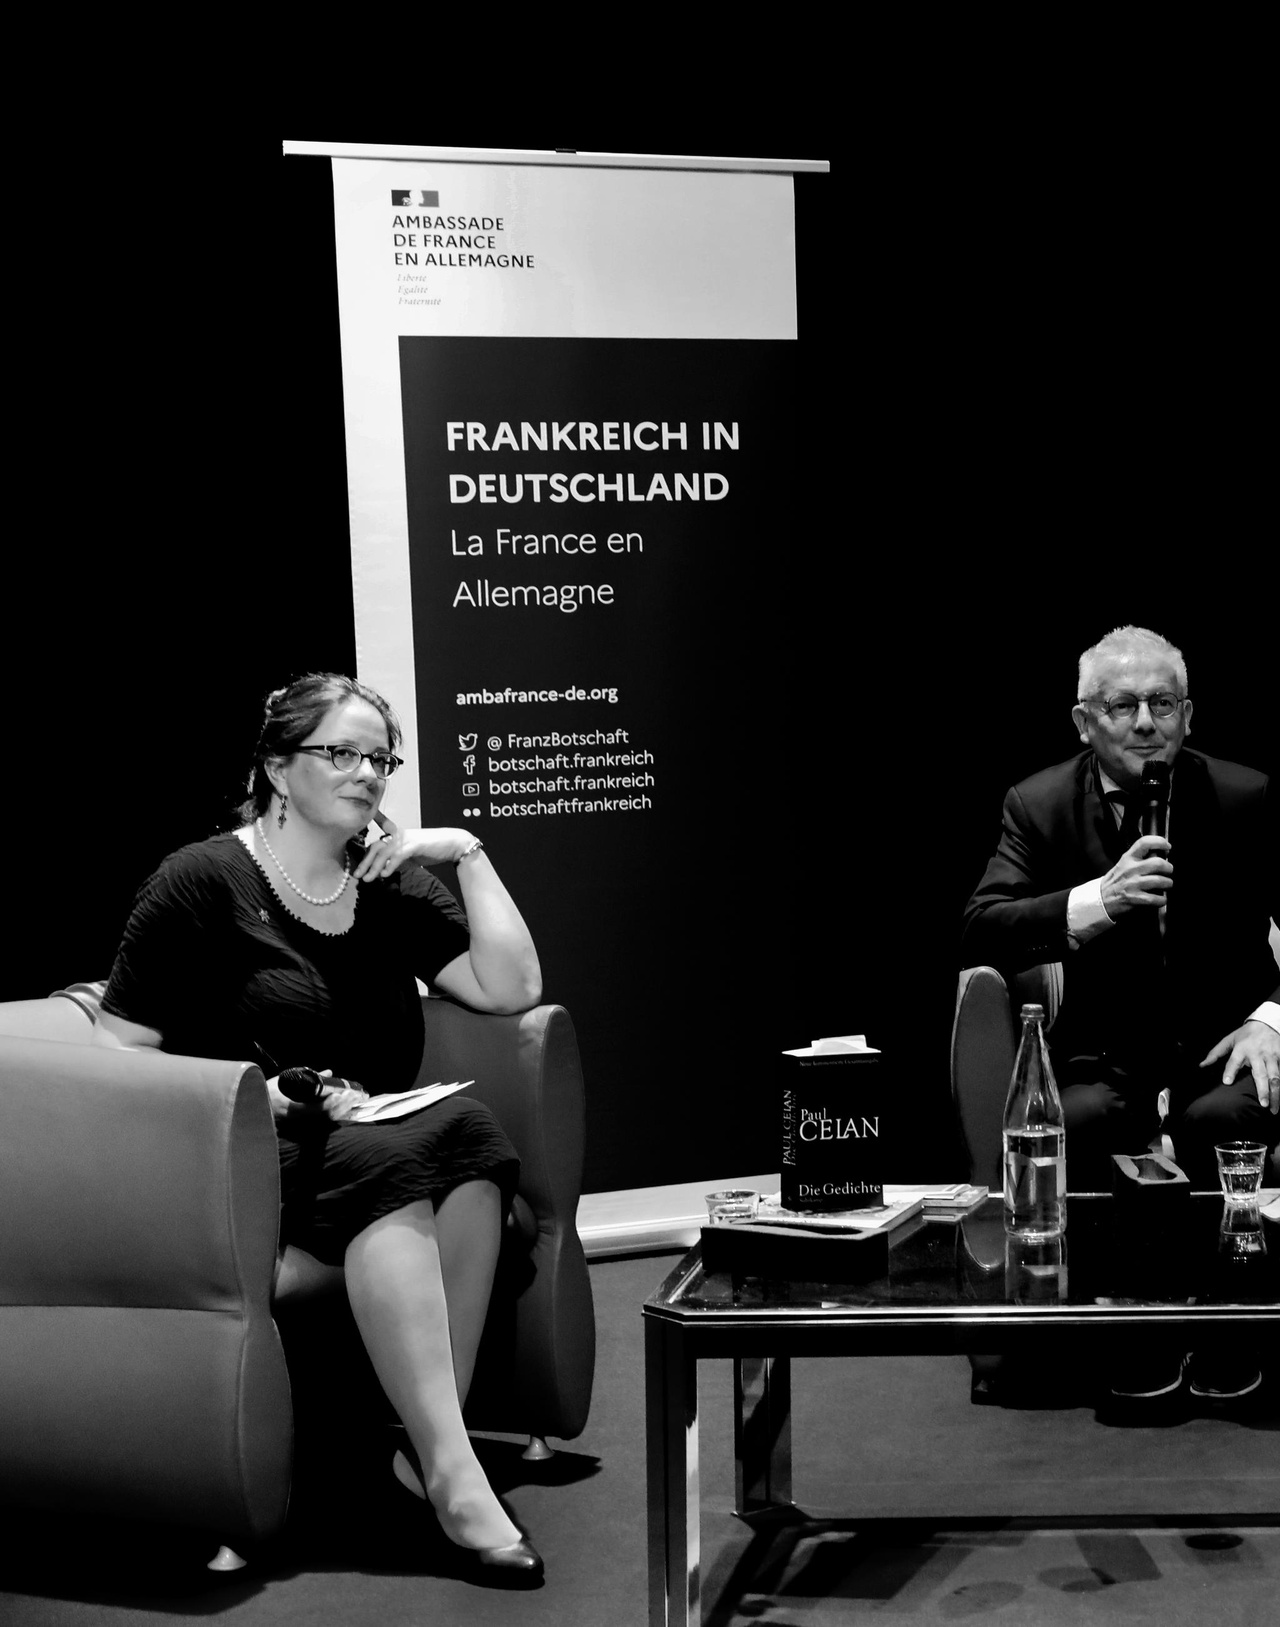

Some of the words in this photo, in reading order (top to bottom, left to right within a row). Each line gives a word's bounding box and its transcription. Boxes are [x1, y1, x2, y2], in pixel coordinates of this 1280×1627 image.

[392, 215, 505, 231] AMBASSADE
[393, 233, 417, 248] DE
[423, 234, 497, 249] FRANCE
[394, 252, 419, 266] EN
[425, 252, 535, 268] ALLEMAGNE
[446, 422, 688, 451] FRANKREICH
[702, 421, 740, 450] IN
[449, 472, 730, 503] DEUTSCHLAND
[451, 529, 484, 556] La
[496, 528, 597, 555] France
[607, 532, 644, 554] en
[452, 579, 615, 613] Allemagne
[456, 686, 618, 705] ambafrance-de.org
[487, 736, 502, 751] @
[507, 729, 629, 749] FranzBotschaft
[488, 750, 654, 772] botschaft.frankreich
[489, 773, 655, 795] botschaft.frankreich
[490, 795, 652, 818] botschaftfrankreich
[782, 1089, 792, 1131] CELAN
[800, 1108, 827, 1121] Paul
[799, 1116, 880, 1142] CELAN
[782, 1132, 791, 1165] PAUL
[799, 1183, 821, 1197] Die
[823, 1180, 881, 1196] Gedichte
